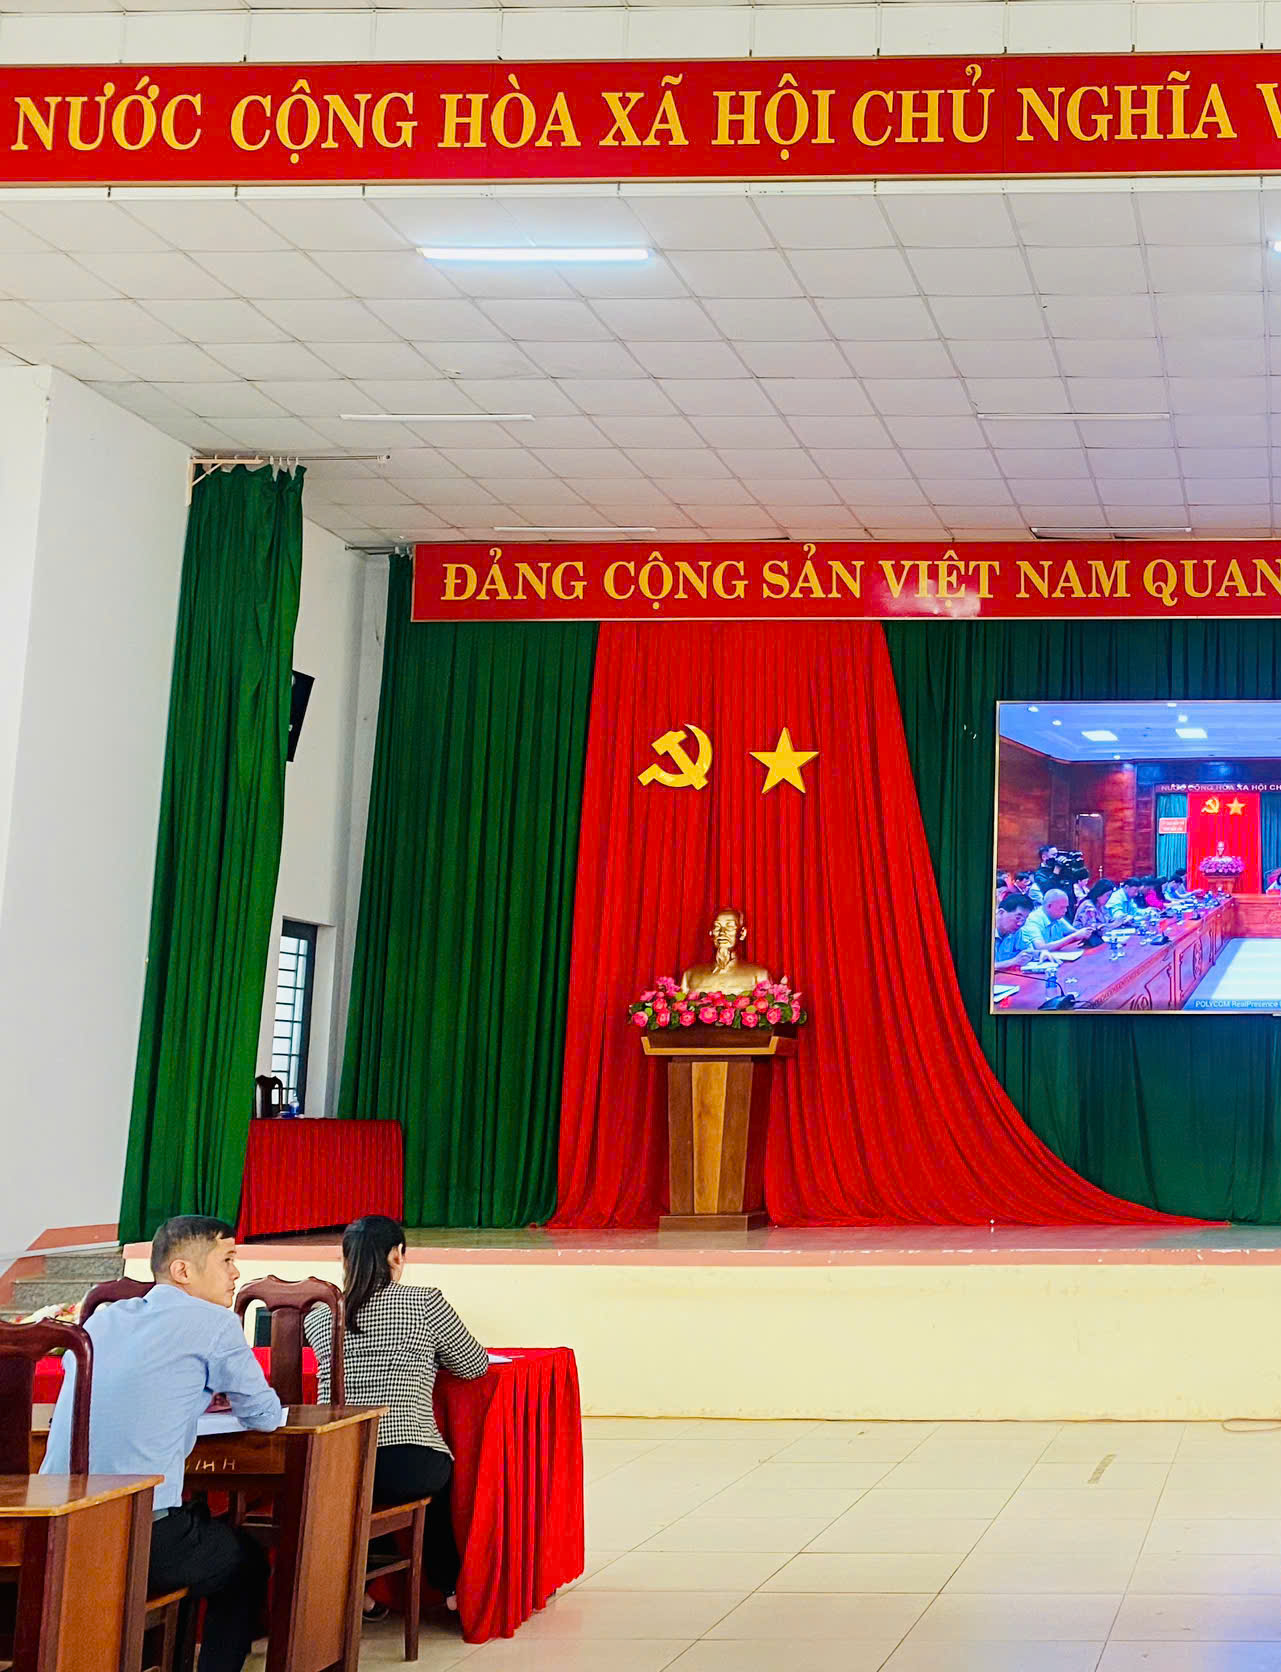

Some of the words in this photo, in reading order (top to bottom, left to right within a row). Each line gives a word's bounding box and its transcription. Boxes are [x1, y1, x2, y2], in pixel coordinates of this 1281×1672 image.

[10, 76, 203, 154] NƯỚC
[230, 78, 418, 164] CỘNG
[437, 73, 582, 149] HÒA
[598, 73, 690, 147] XÃ
[712, 73, 836, 161] HỘI
[852, 63, 995, 146] CHỦ
[1016, 71, 1238, 144] NGHĨA
[440, 547, 587, 602] ĐẢNG
[603, 551, 749, 610] CỘNG
[762, 543, 866, 600] SẢN
[877, 549, 1000, 609] VIỆT
[1015, 559, 1131, 599] NAM
[1195, 1000, 1230, 1008] POLYCOM
[1231, 1000, 1278, 1008] RealPresence
